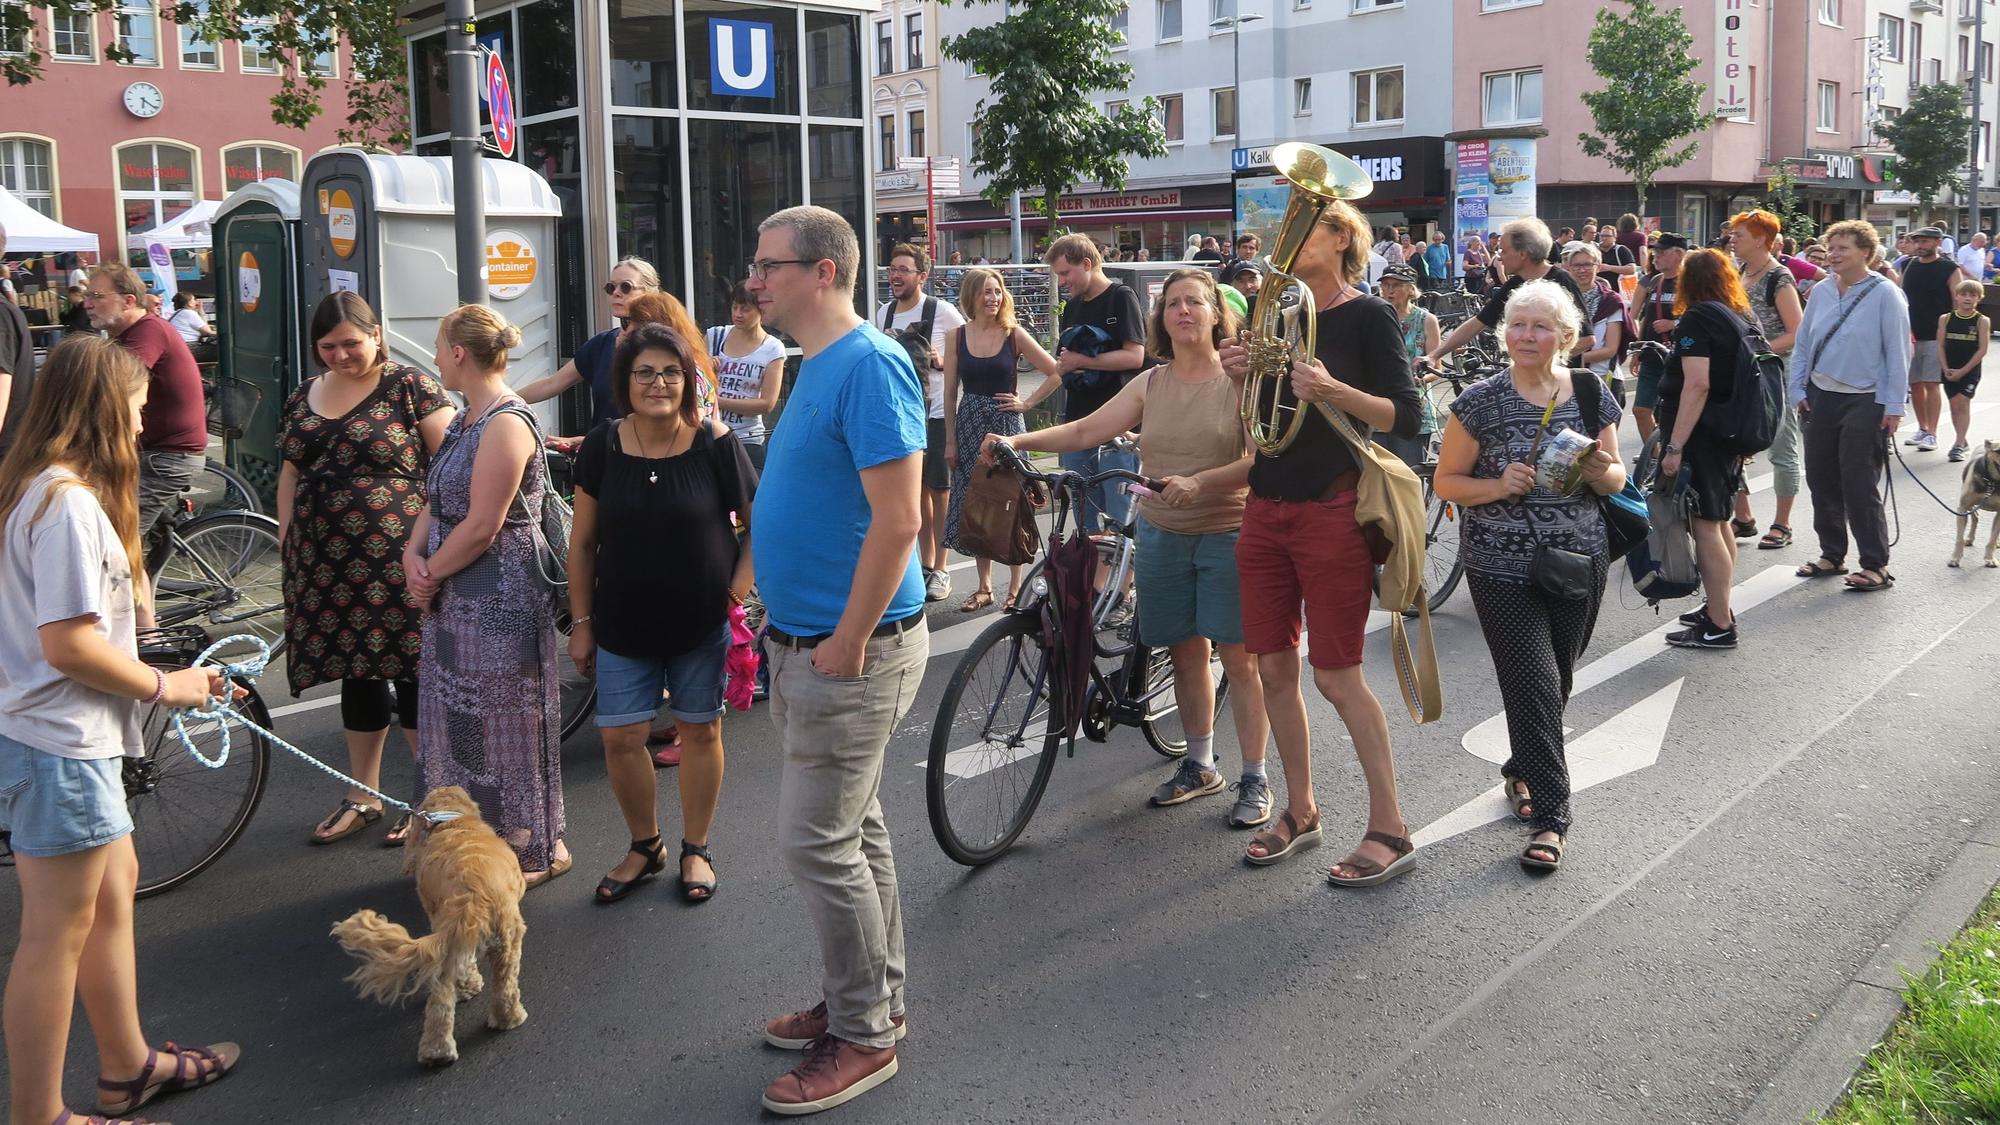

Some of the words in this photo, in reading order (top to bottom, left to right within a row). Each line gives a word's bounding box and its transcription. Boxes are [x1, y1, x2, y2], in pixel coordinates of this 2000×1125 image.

[716, 24, 767, 90] U
[1234, 151, 1246, 167] U
[1250, 151, 1271, 164] Kalk
[1090, 195, 1138, 209] MARKET
[1140, 193, 1178, 206] GmbH
[488, 262, 529, 272] ontainer
